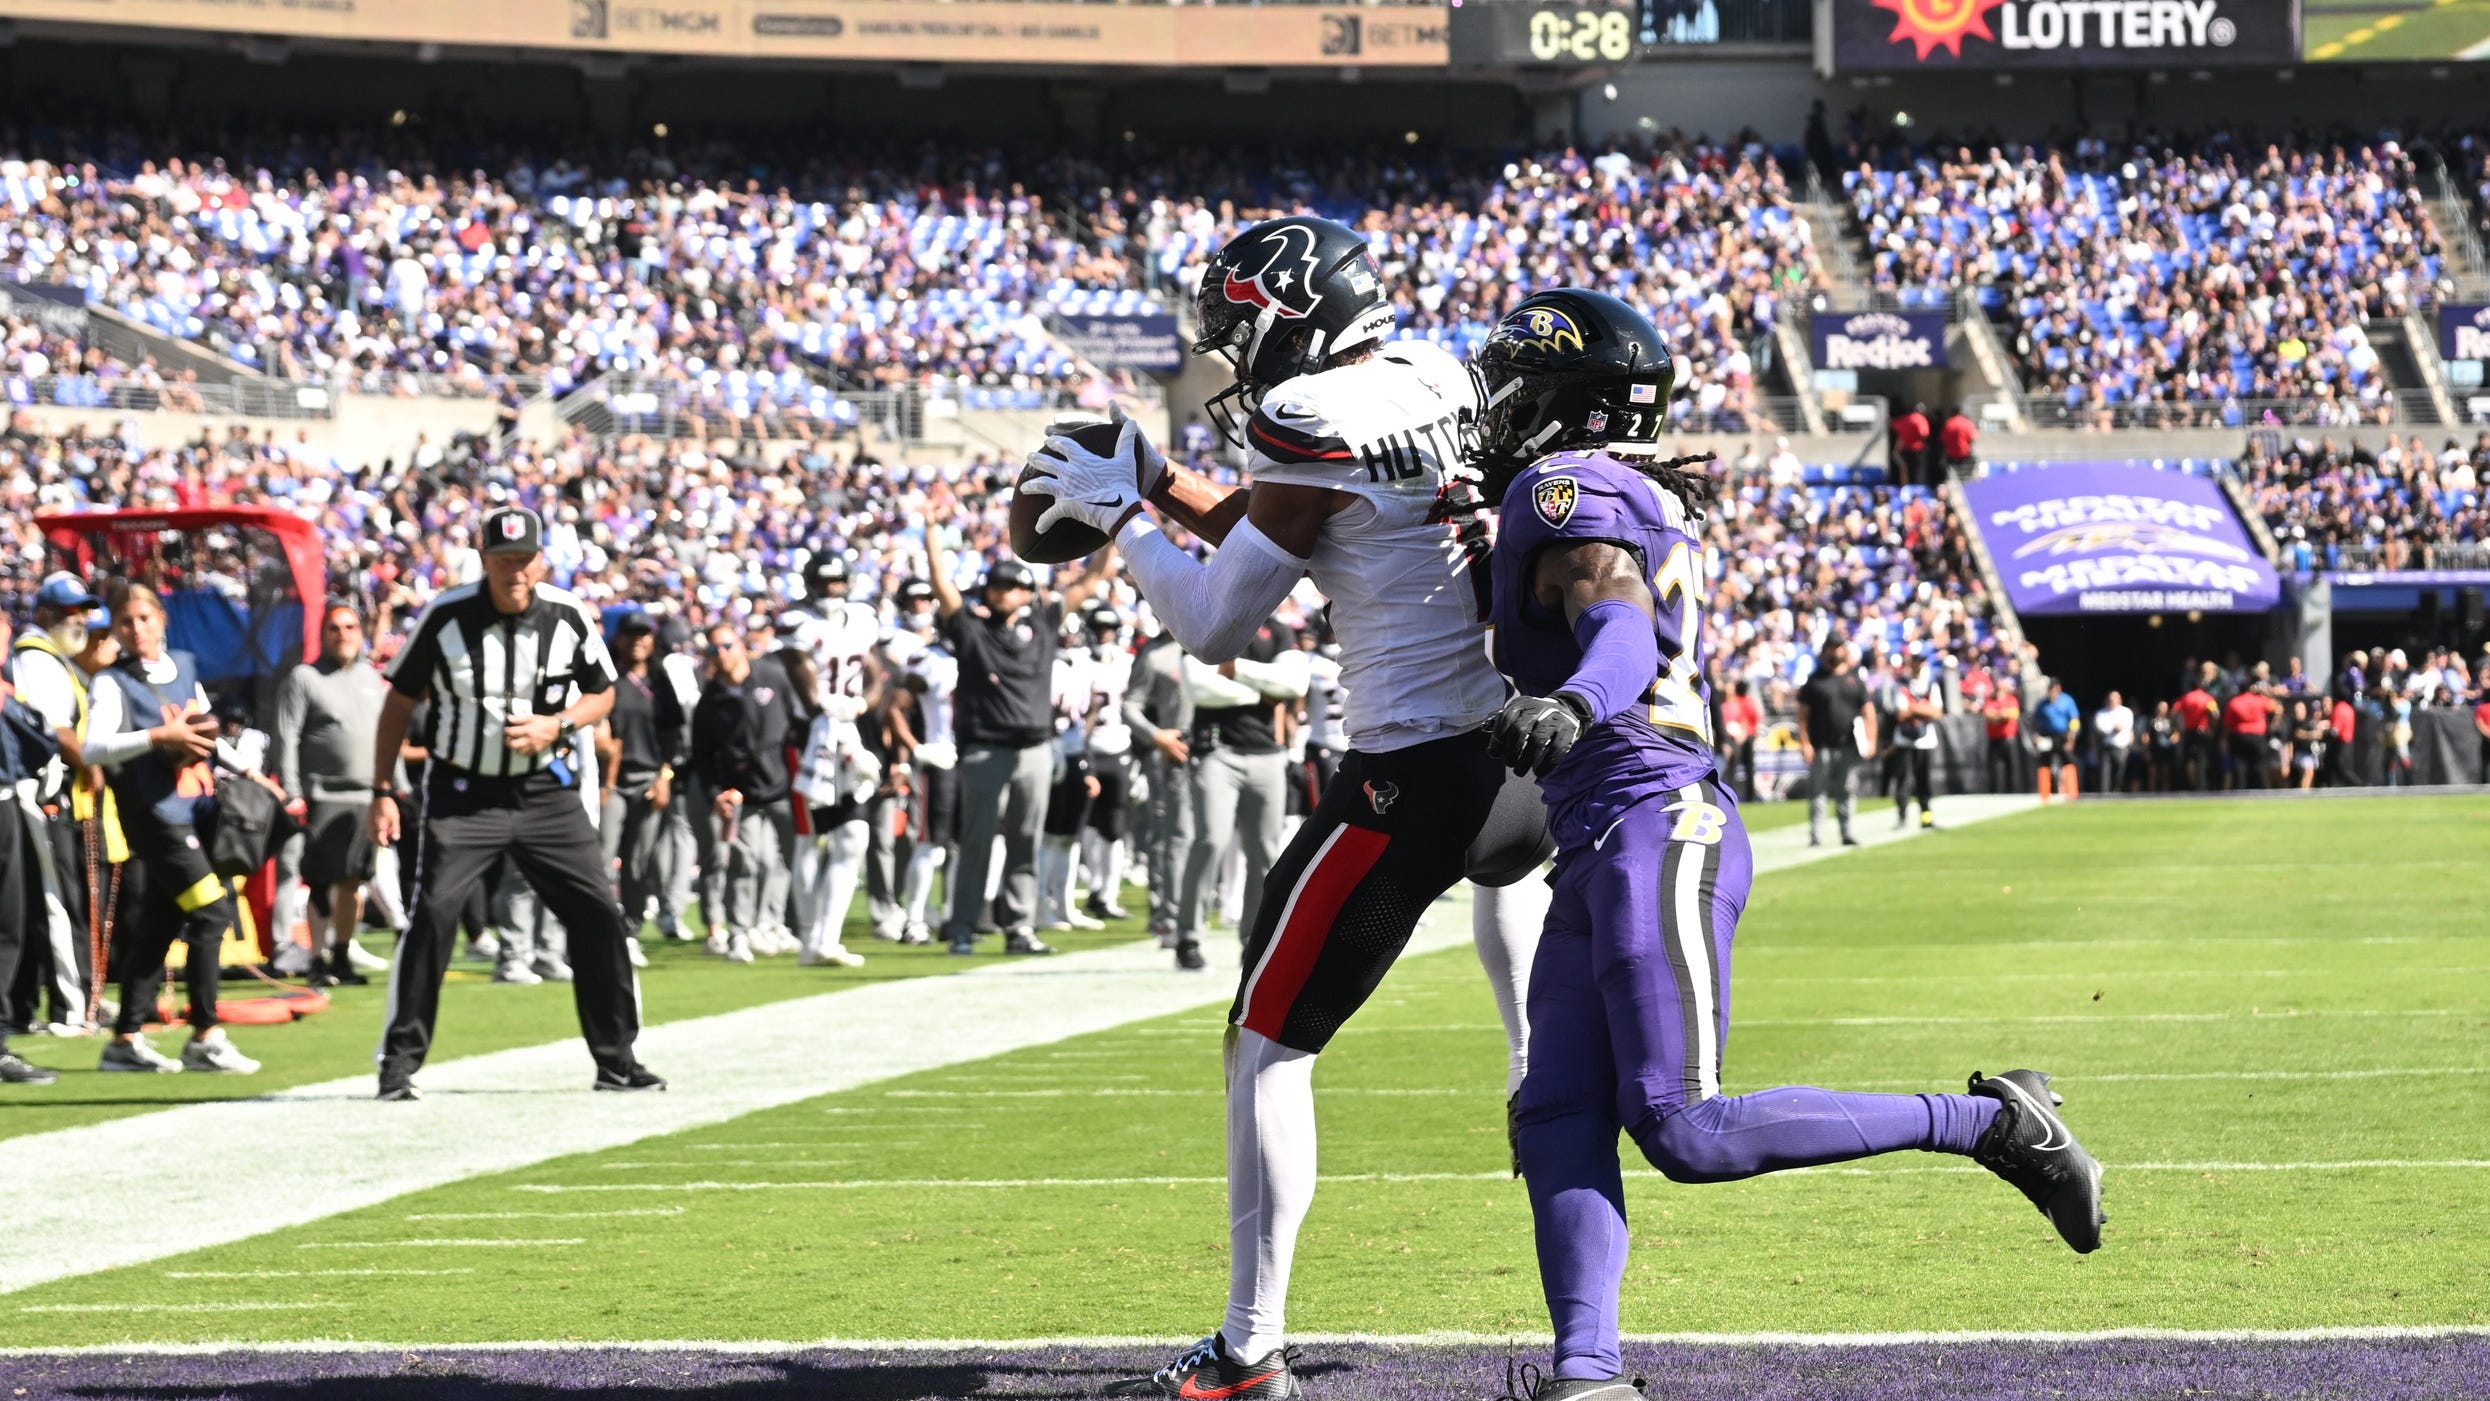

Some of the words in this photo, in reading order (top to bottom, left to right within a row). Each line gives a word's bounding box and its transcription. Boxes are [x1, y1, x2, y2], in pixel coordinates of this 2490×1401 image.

[1530, 11, 1630, 60] 0:28
[1537, 479, 1571, 492] RAVENS
[2078, 590, 2164, 611] MEDSTAR
[2166, 590, 2234, 610] HEALTH
[827, 652, 867, 699] 12
[1660, 800, 1728, 846] B
